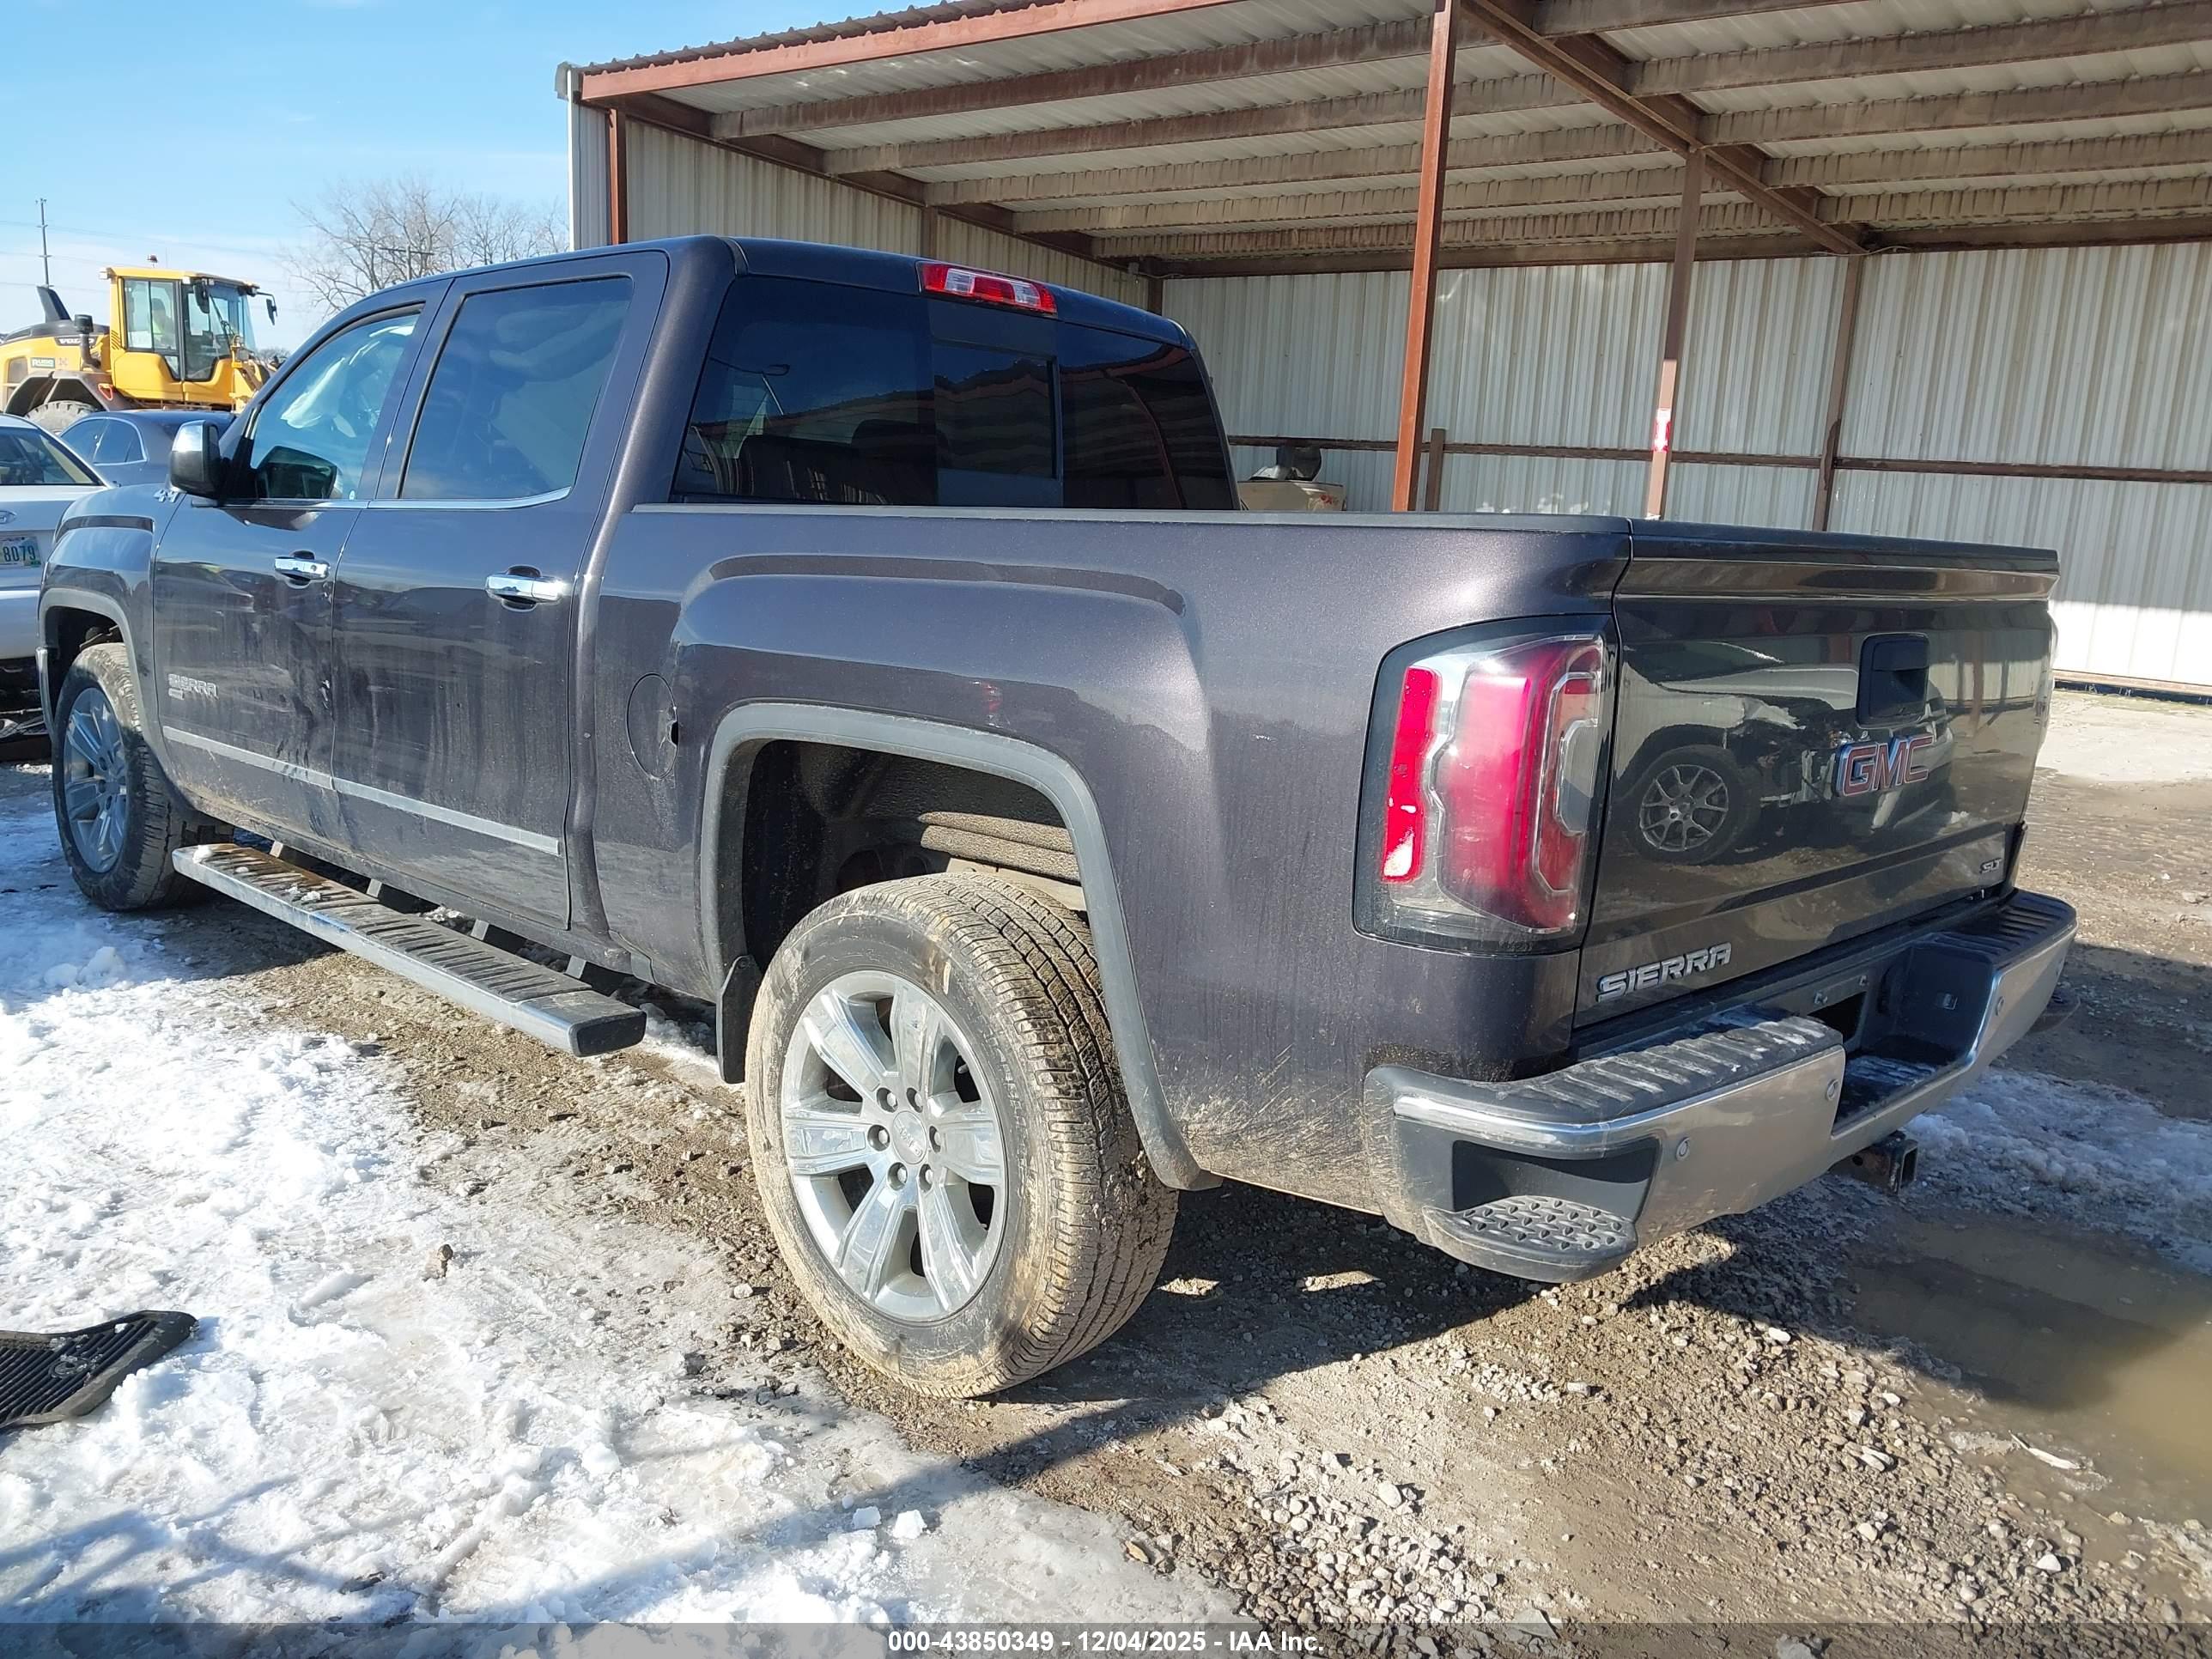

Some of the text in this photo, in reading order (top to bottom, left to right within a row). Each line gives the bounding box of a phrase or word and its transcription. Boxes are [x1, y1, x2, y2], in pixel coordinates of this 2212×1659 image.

[3, 545, 36, 562] 8079
[168, 674, 218, 698] SIERRA
[1838, 734, 1934, 797] GMC
[1596, 942, 1732, 1003] SIERRA
